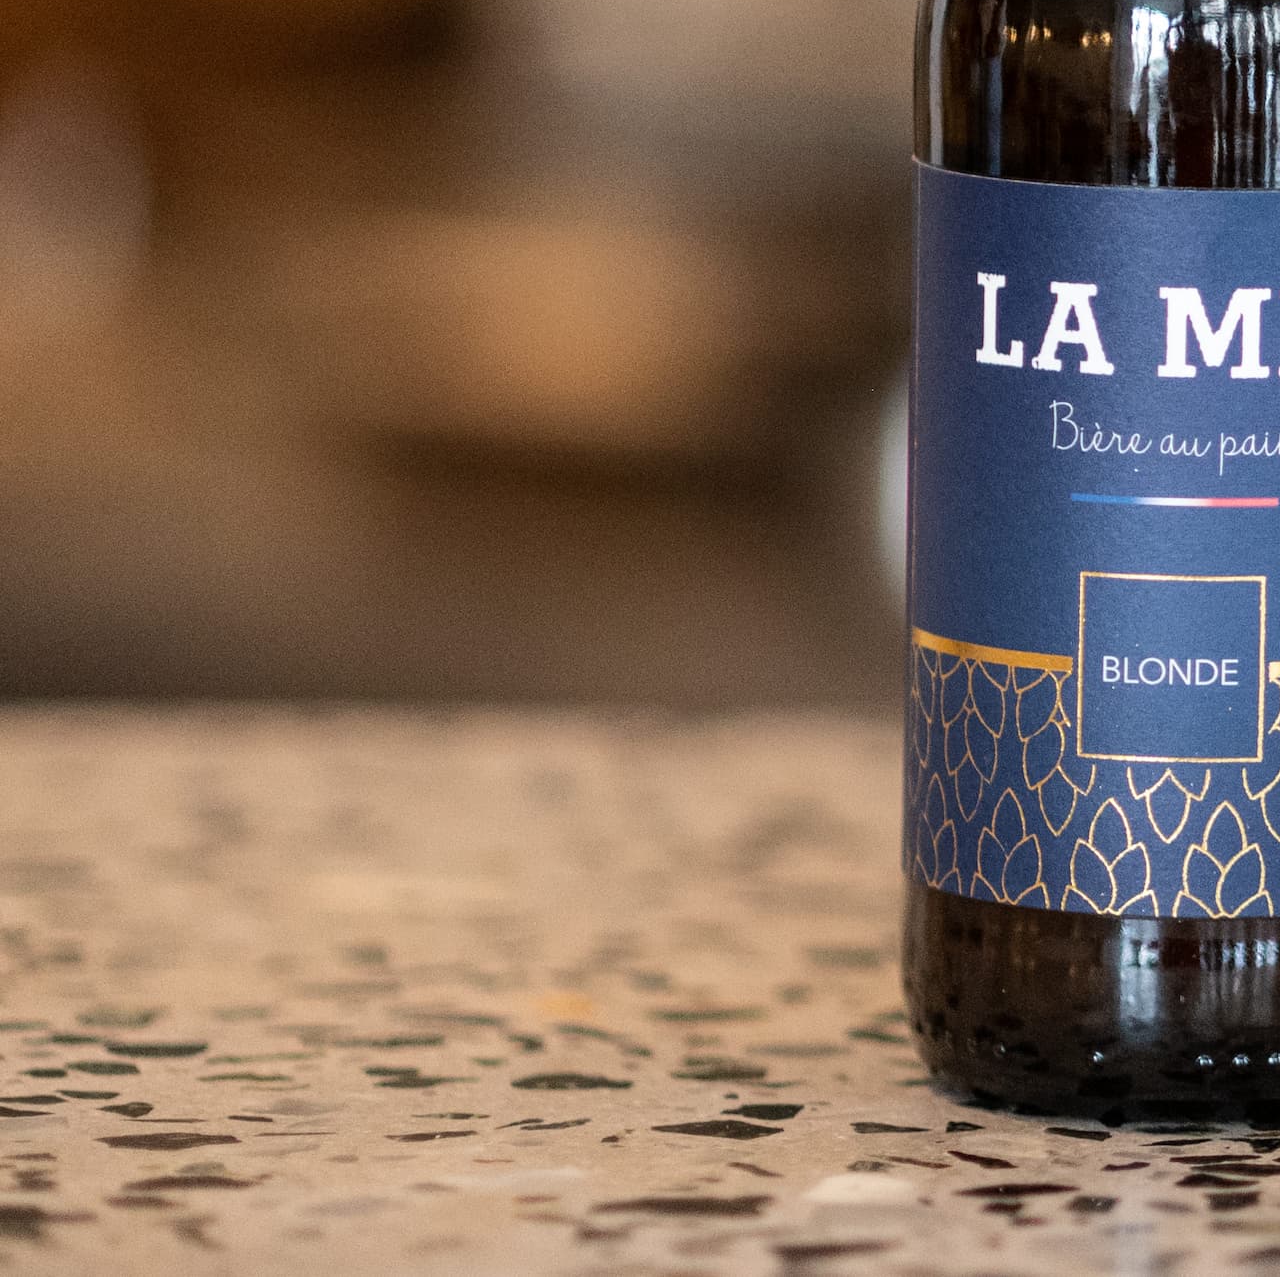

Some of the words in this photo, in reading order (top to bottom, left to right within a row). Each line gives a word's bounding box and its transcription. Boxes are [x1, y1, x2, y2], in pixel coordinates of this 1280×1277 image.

[975, 271, 1116, 376] LA
[1048, 399, 1153, 455] Bière
[1159, 431, 1212, 458] au
[1101, 654, 1240, 687] BLONDE
